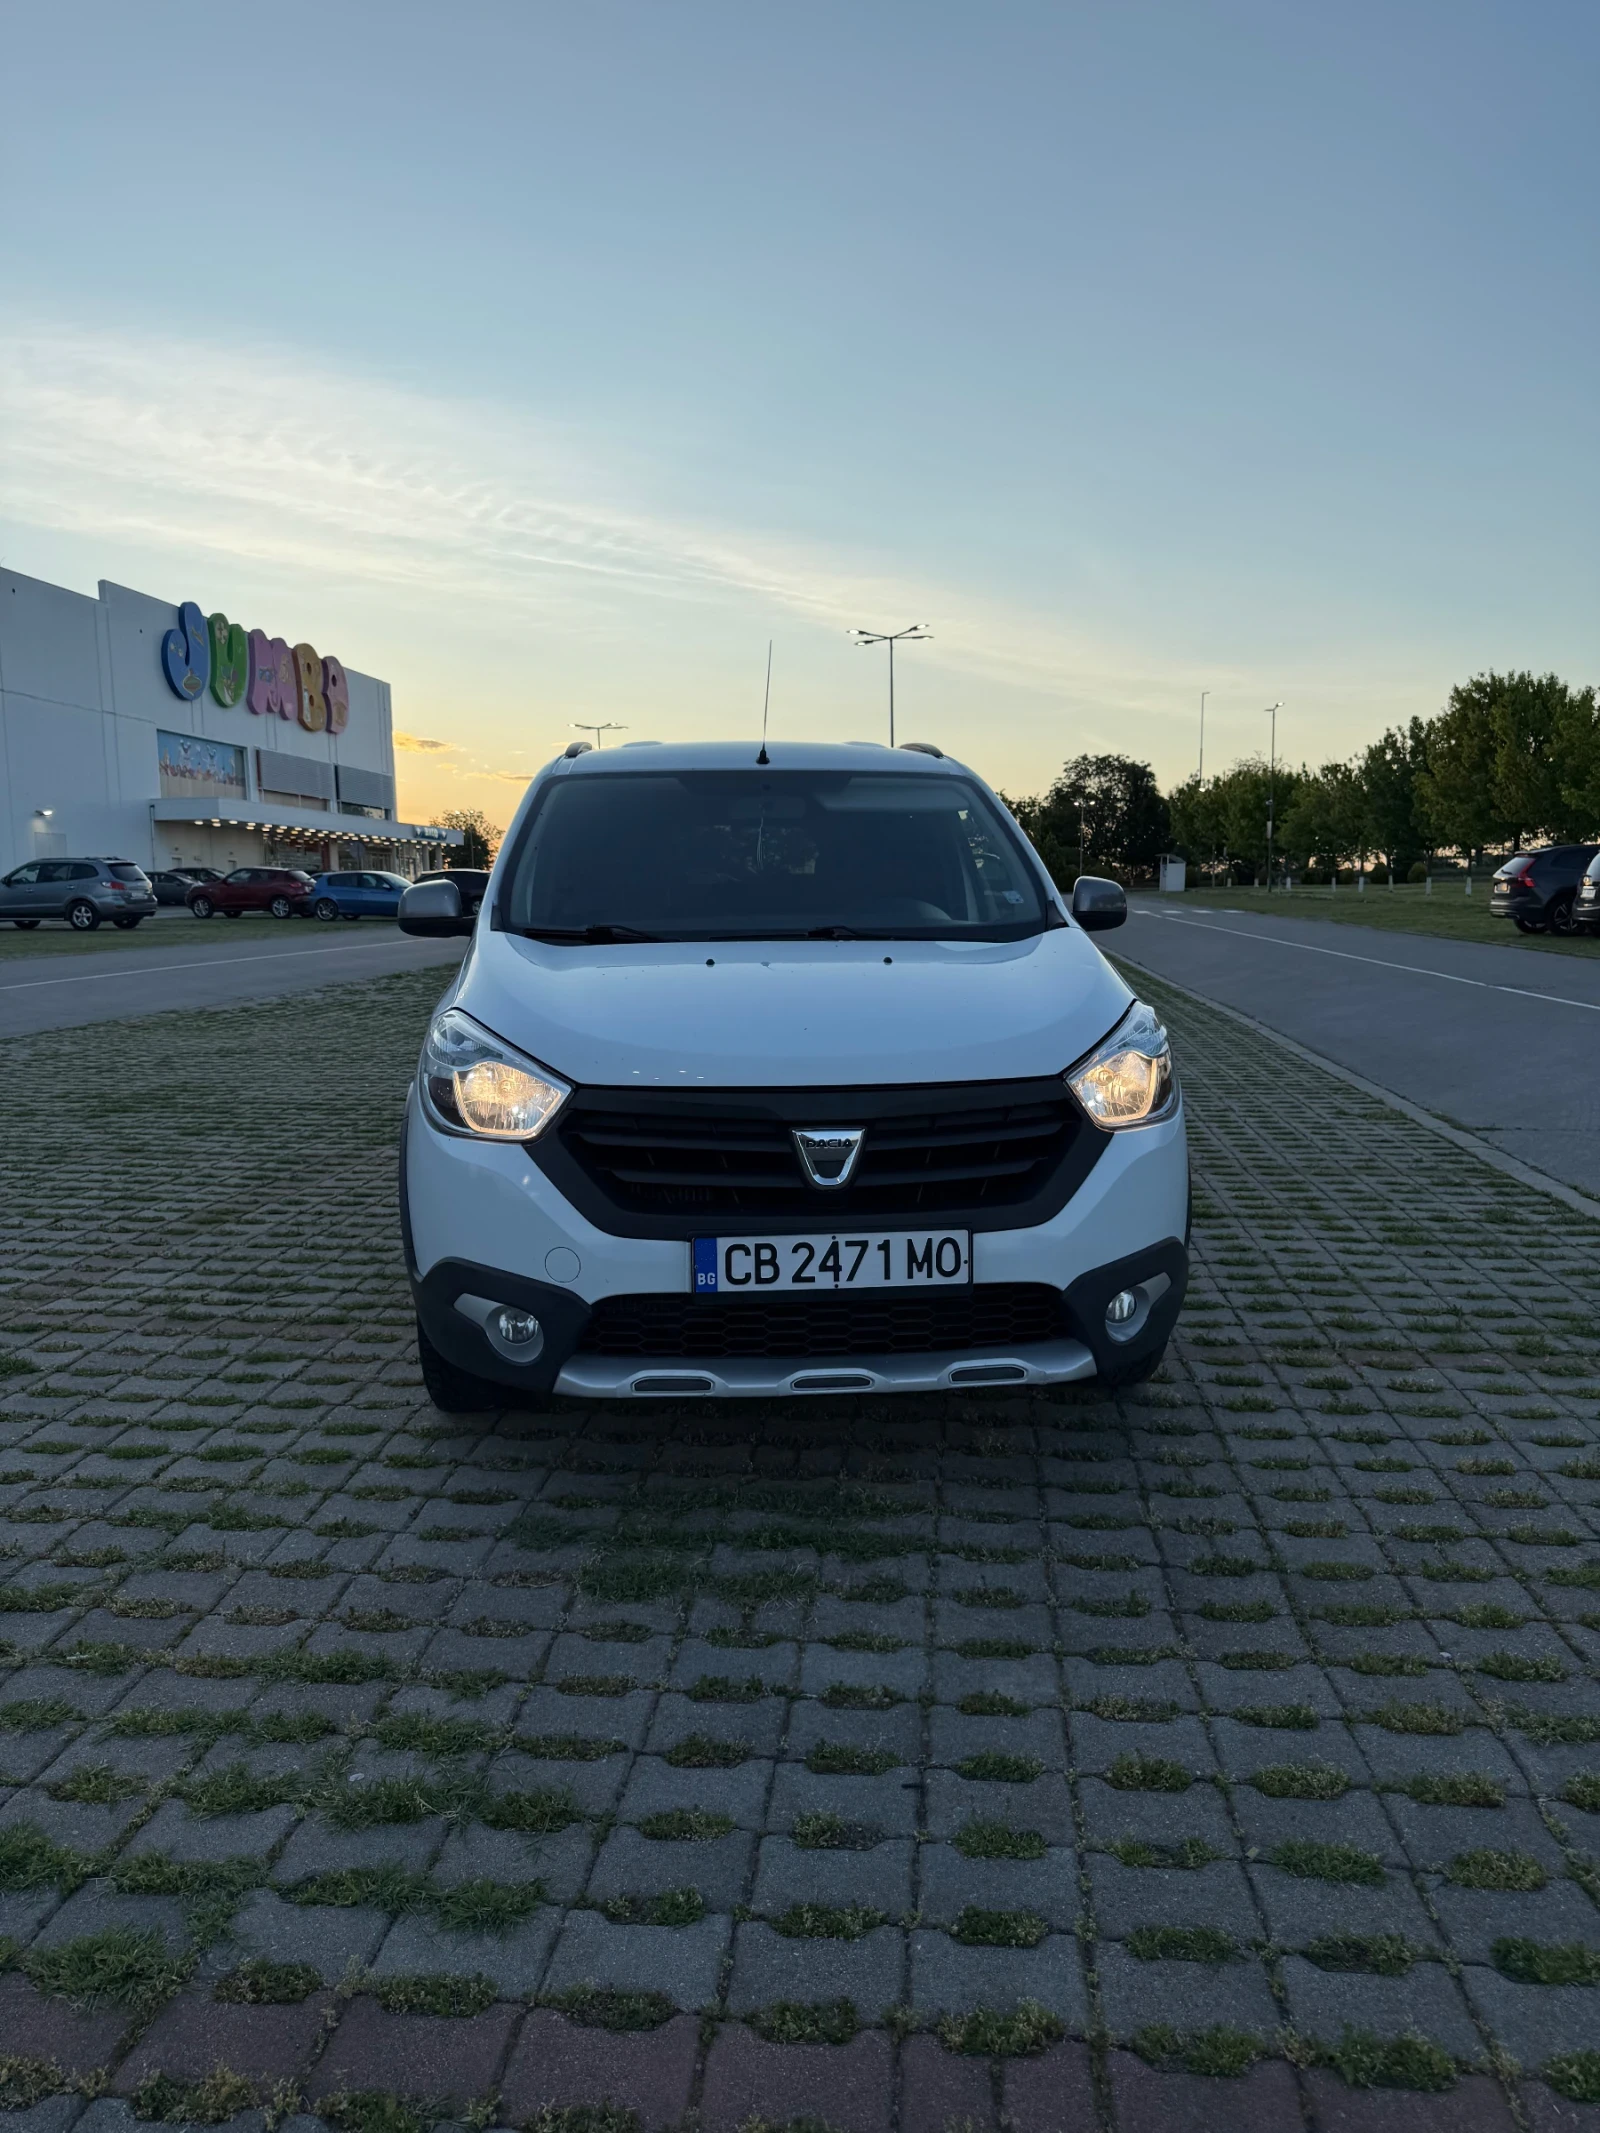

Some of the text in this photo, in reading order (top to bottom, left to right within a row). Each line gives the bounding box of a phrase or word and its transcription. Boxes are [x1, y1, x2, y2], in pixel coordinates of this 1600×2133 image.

[162, 601, 347, 734] JUMBO
[806, 1138, 852, 1148] DACIA
[725, 1236, 961, 1285] CB 2471 MO
[697, 1273, 716, 1285] BG
